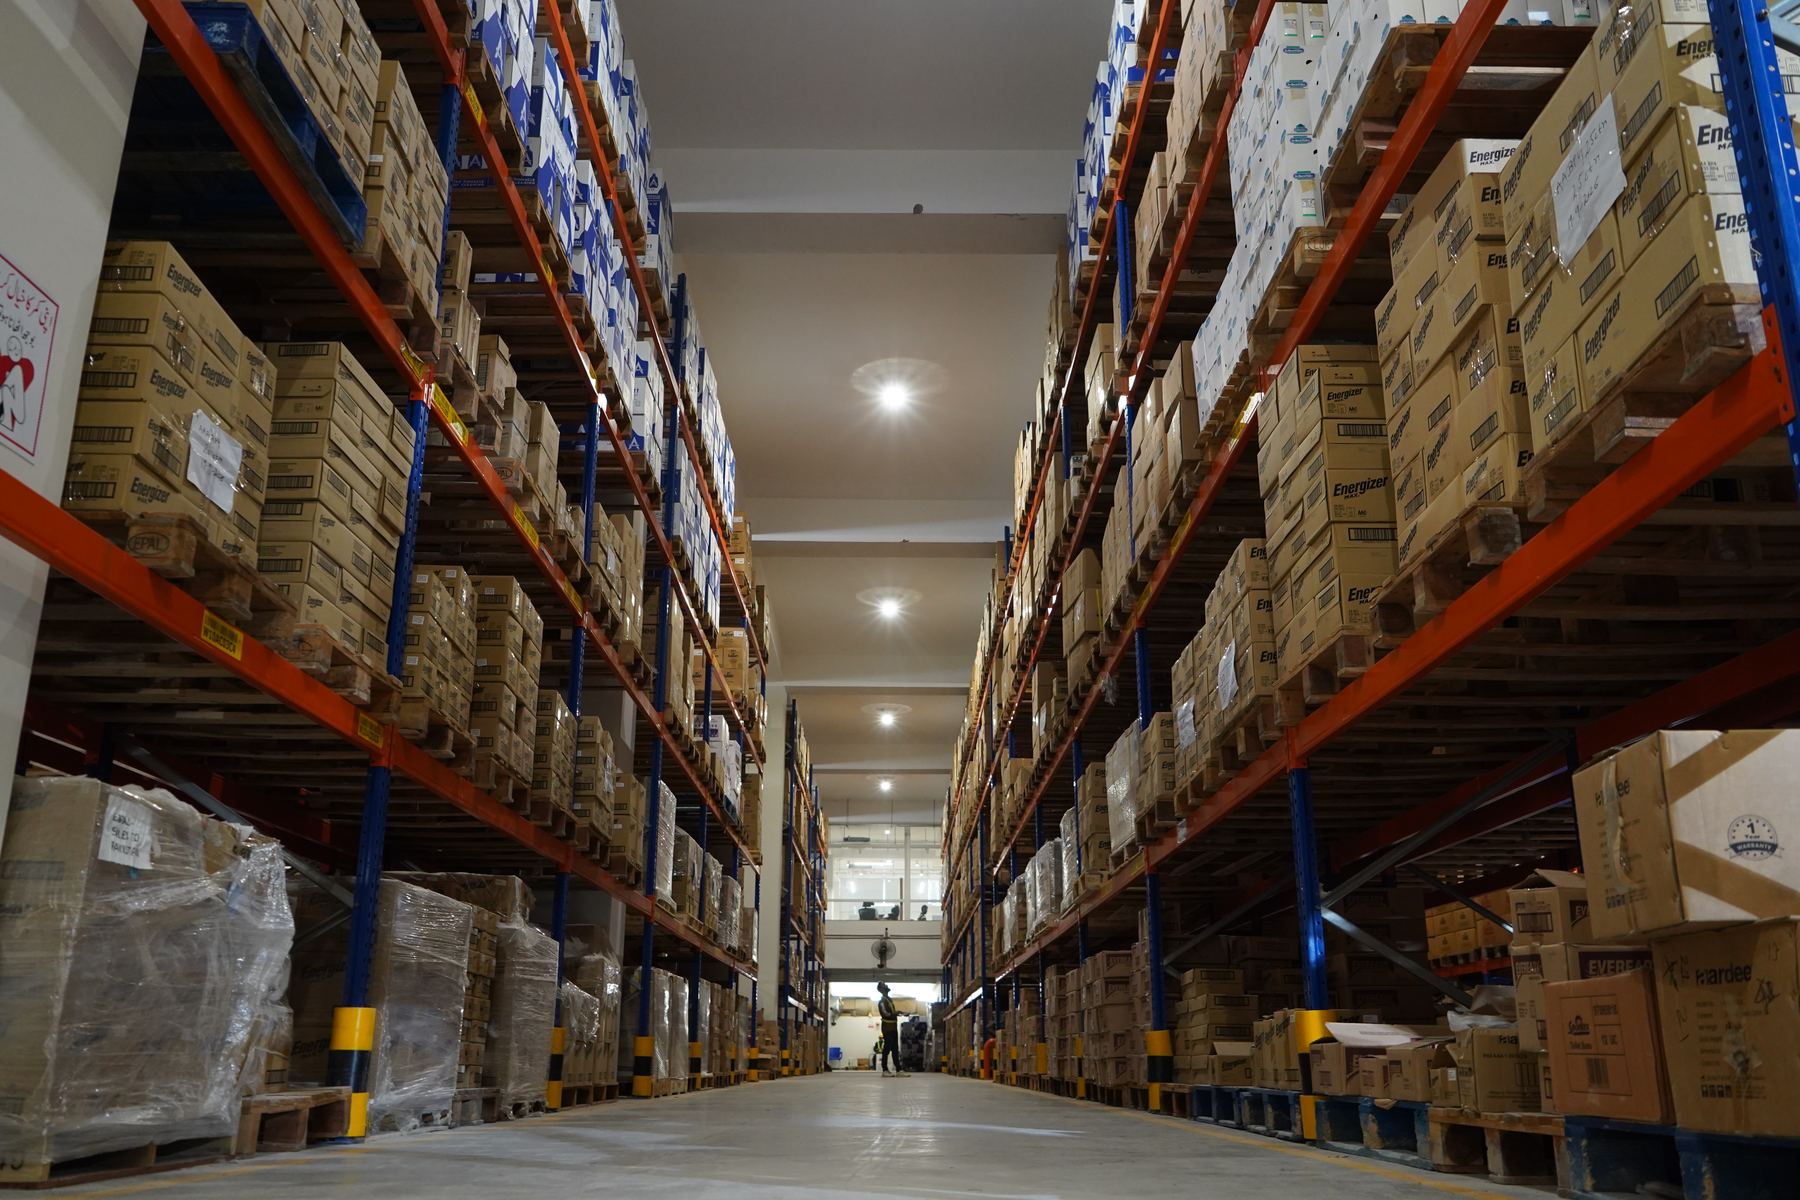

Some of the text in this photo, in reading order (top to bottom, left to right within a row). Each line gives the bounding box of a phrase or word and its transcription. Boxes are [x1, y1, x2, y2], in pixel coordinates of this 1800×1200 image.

[1470, 147, 1516, 164] Energize
[1503, 136, 1533, 203] Energizer
[1622, 150, 1653, 218] Energizer
[167, 262, 202, 298] Energizer
[1524, 280, 1553, 345] Energizer
[1585, 291, 1620, 365] Energizer
[150, 369, 187, 399] Energizer
[201, 361, 233, 388] Energizer
[1327, 387, 1364, 402] Energizer
[131, 476, 171, 504] Energizer
[1333, 476, 1389, 498] Energizer
[1747, 822, 1756, 835] 1
[1736, 842, 1773, 851] WARRANTY
